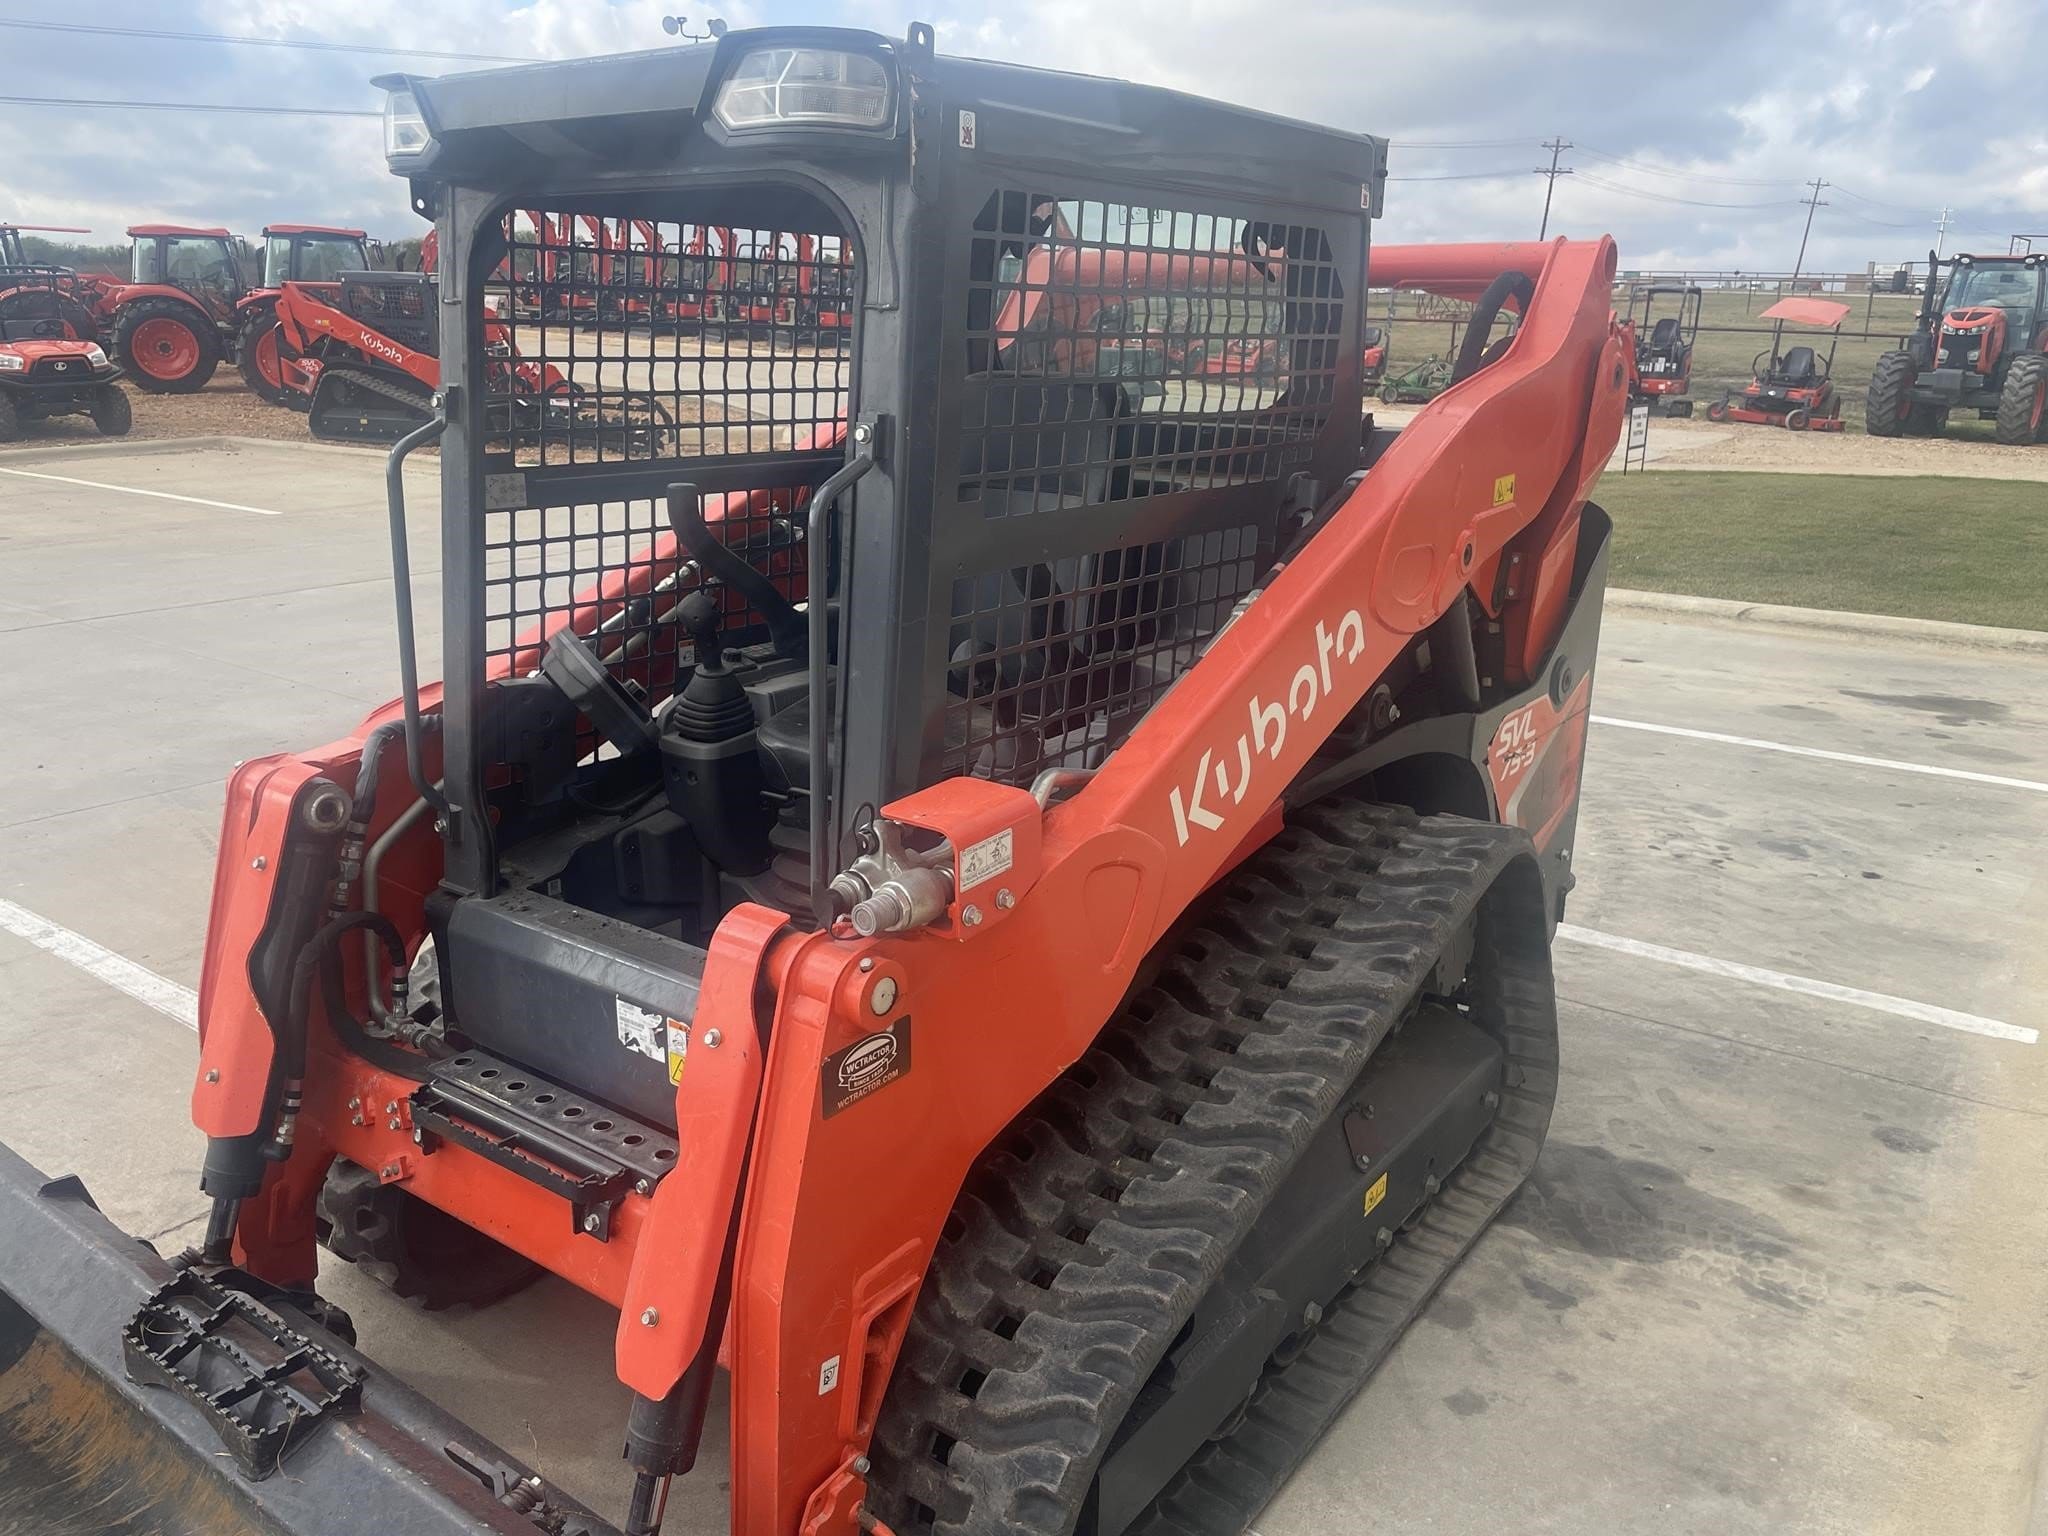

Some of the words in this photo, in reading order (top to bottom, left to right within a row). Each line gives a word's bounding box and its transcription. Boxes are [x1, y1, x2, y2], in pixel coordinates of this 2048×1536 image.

[301, 359, 318, 367] SVL
[360, 330, 403, 363] Kubota
[1169, 609, 1366, 848] Kubota
[1495, 708, 1537, 758] SVL
[845, 1044, 891, 1075] WCTRACTOR
[837, 1068, 899, 1109] WCTRACTOR.COM
